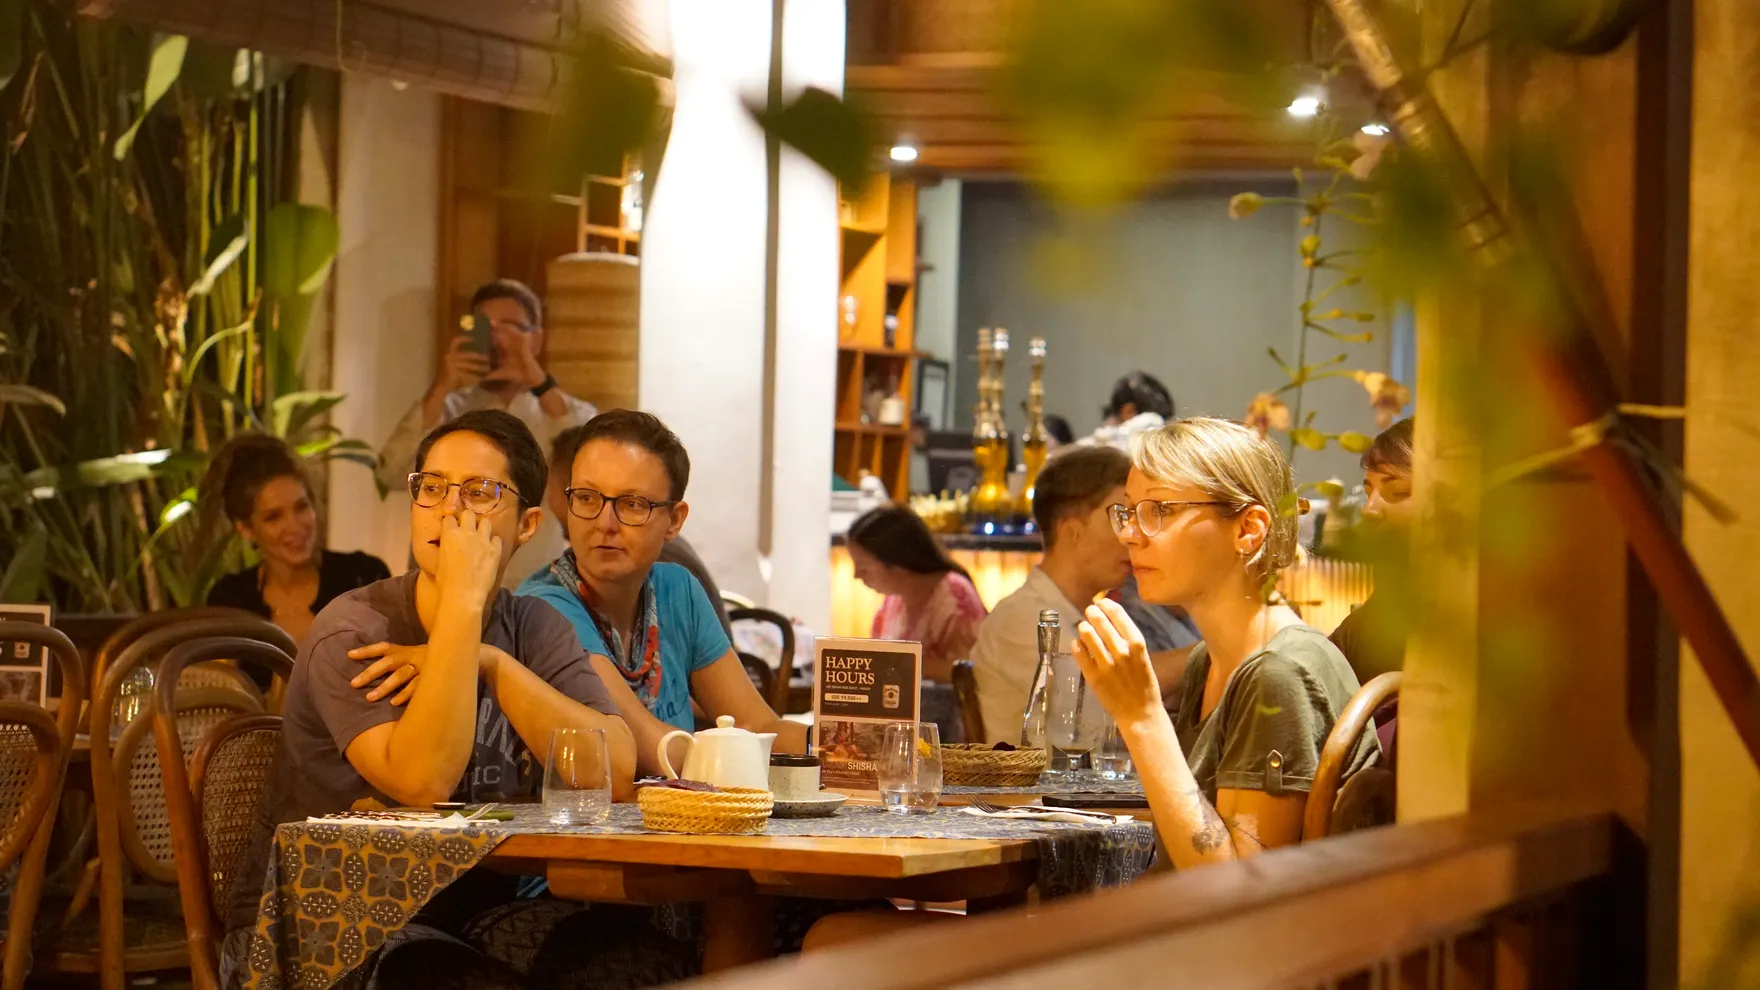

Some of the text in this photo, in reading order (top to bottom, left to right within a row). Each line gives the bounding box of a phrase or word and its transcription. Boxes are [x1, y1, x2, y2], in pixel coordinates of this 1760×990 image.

[825, 656, 873, 670] HAPPY
[825, 670, 875, 685] HOURS
[847, 762, 877, 771] SHISHA
